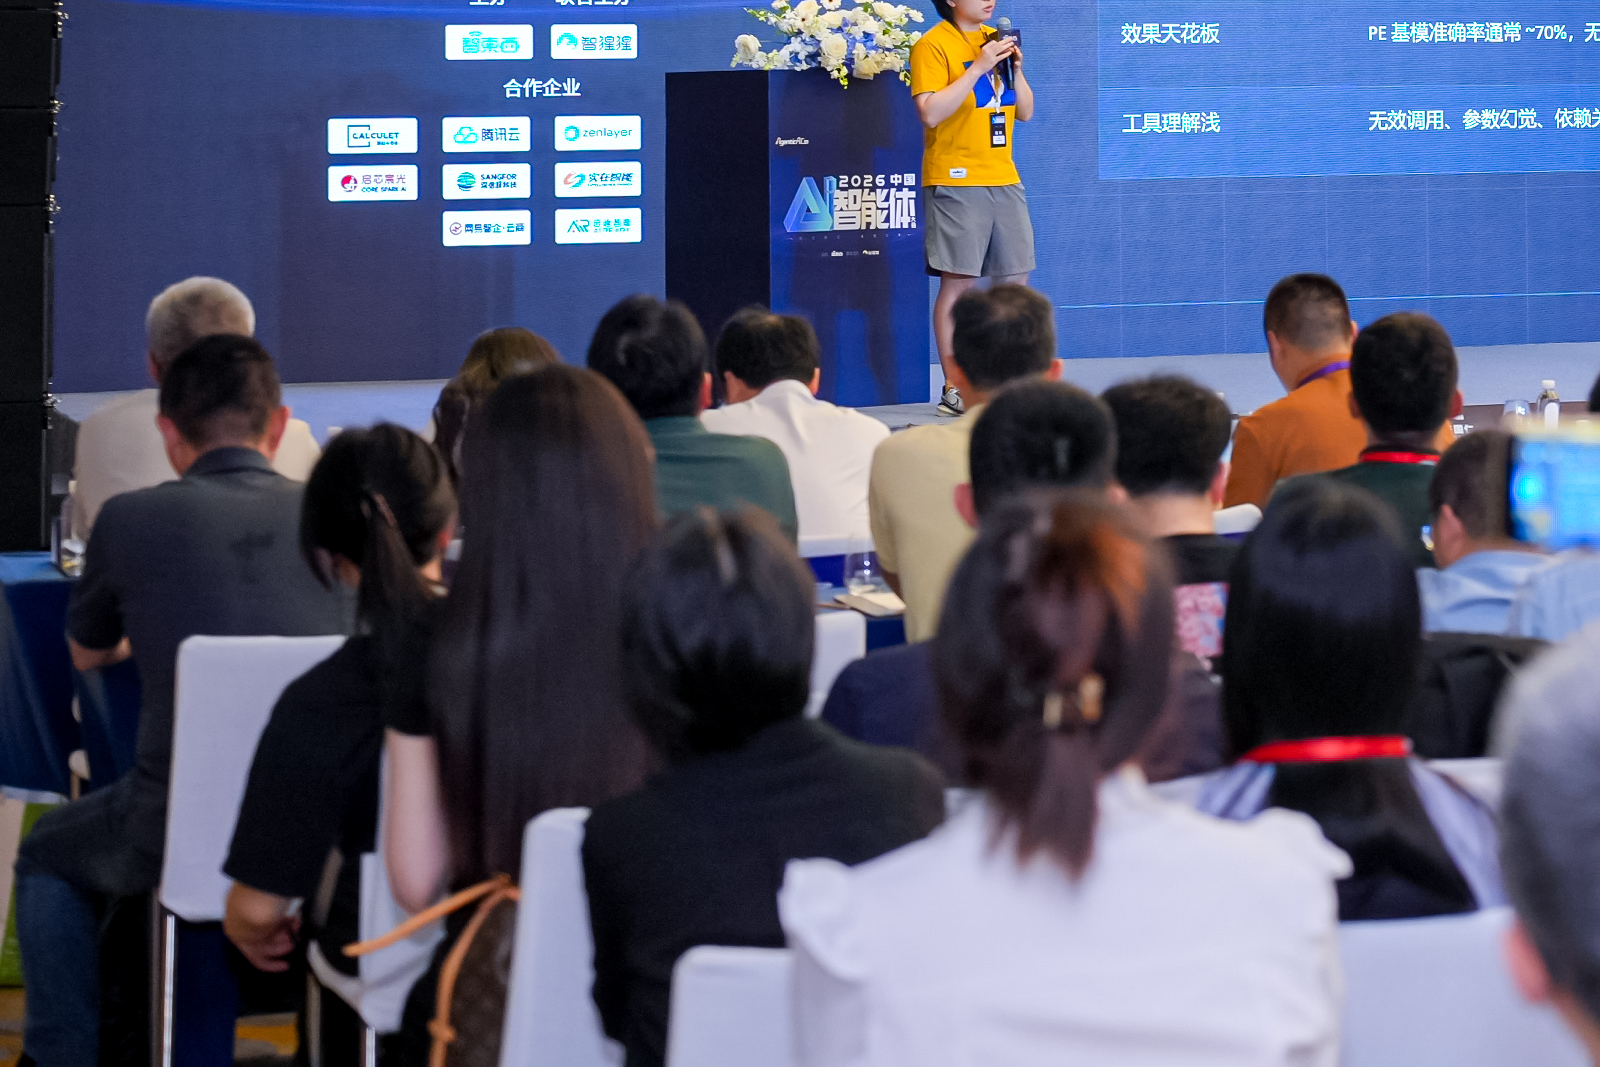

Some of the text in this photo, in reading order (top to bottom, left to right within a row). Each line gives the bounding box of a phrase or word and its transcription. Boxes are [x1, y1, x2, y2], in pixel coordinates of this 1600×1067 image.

[1120, 21, 1220, 45] 效果天花板
[1368, 25, 1387, 41] PE
[1390, 21, 1522, 44] 基模准确率通常
[503, 77, 582, 98] 合作企业
[583, 128, 632, 138] zenlayer
[1121, 111, 1221, 134] 工具理解浅
[838, 173, 916, 188] 2026 中国
[832, 187, 917, 231] 智能体
